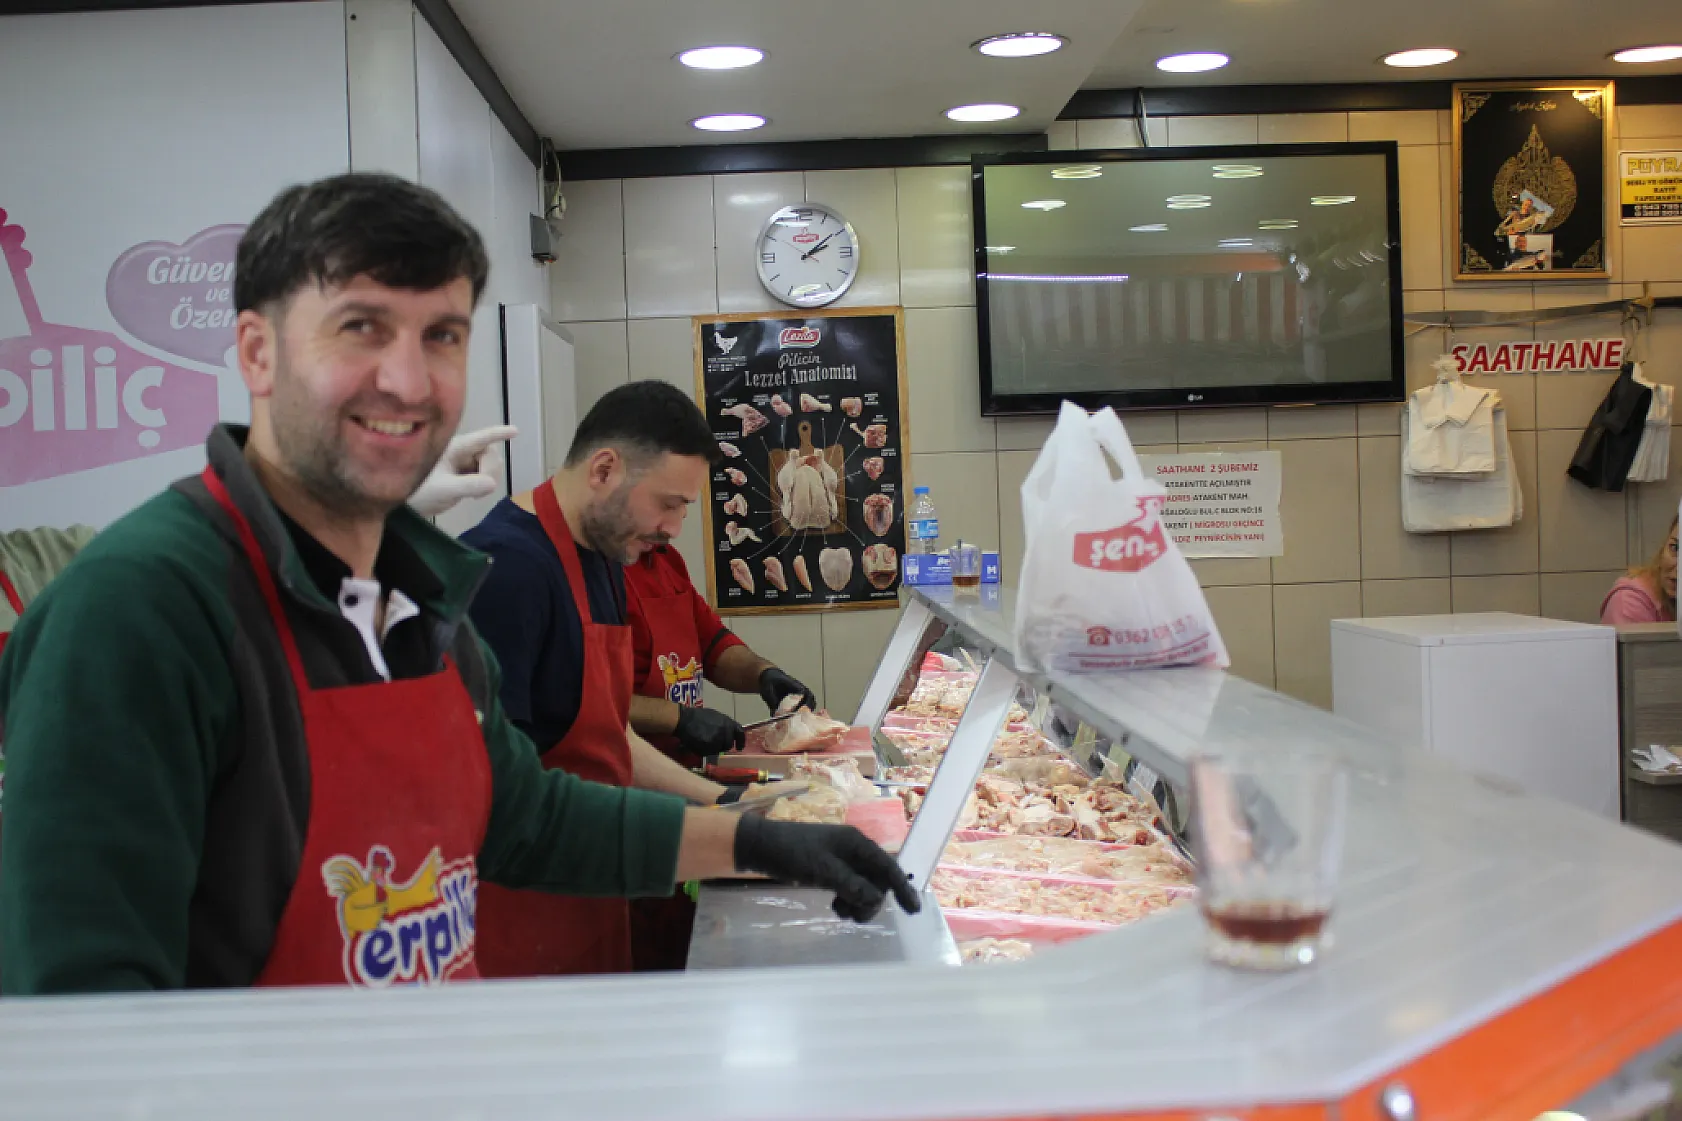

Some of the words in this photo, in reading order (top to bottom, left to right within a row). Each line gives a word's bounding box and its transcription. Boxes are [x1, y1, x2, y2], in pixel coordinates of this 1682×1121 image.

[205, 287, 230, 303] ve
[1452, 339, 1624, 373] SAATHANE
[744, 370, 786, 389] Lezzet
[1156, 464, 1206, 476] SAATHANE
[1209, 464, 1216, 473] 2
[1217, 462, 1260, 474] ŞUBEMİZ
[1192, 493, 1228, 501] ATAKENT
[1089, 534, 1159, 567] şen
[1114, 628, 1150, 645] 0362
